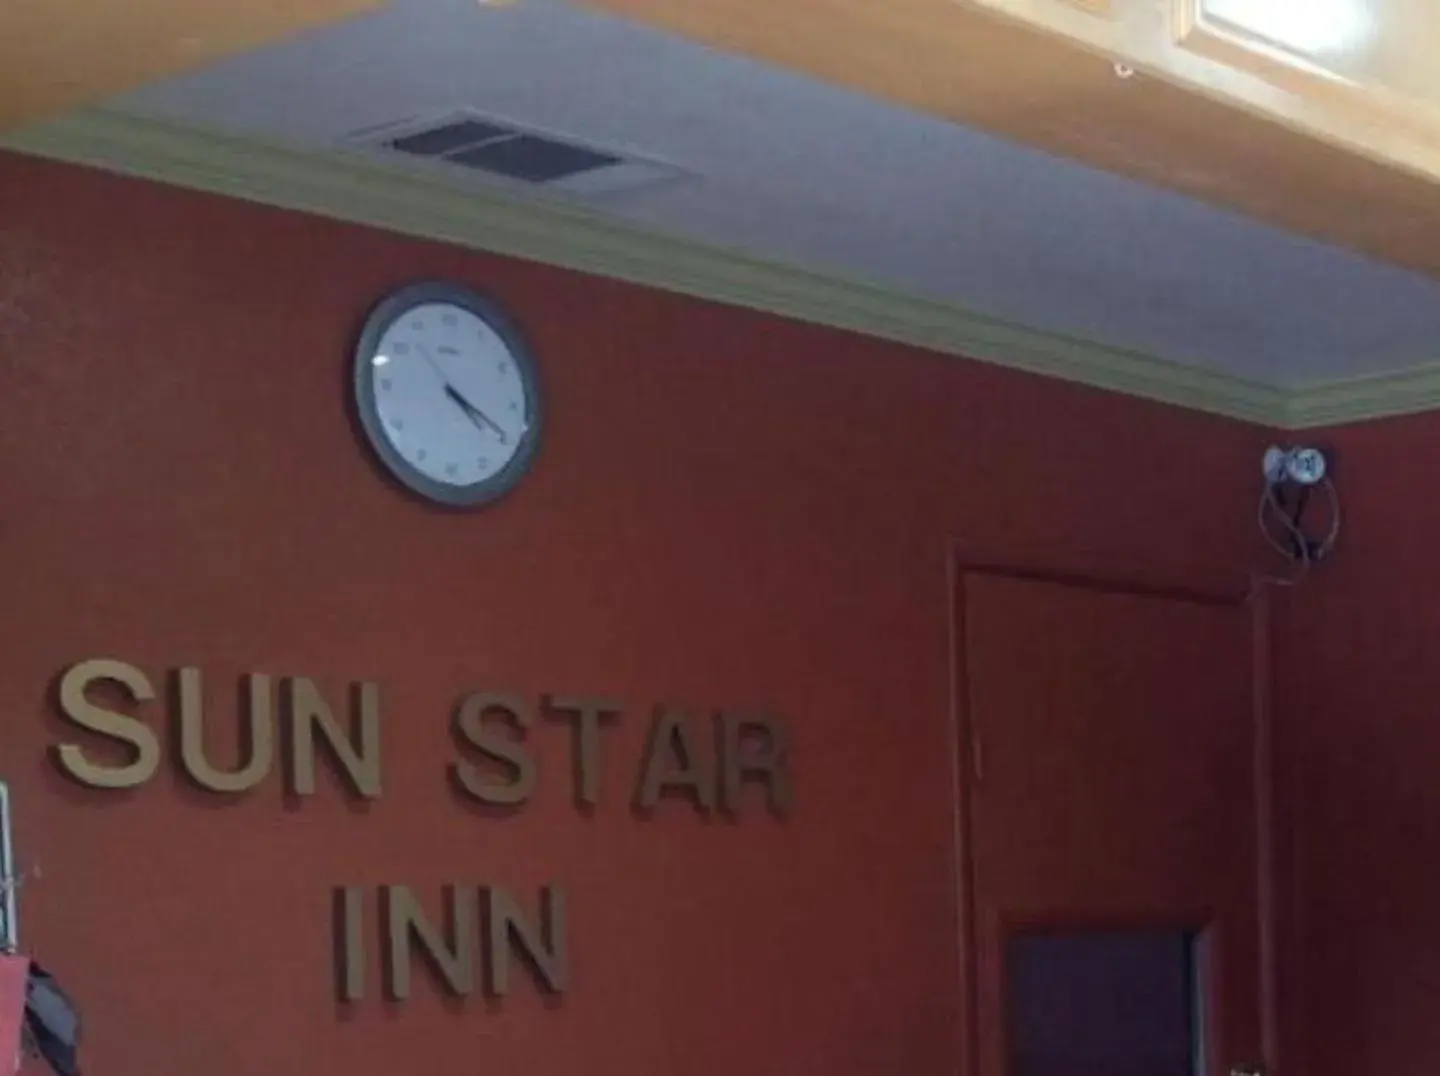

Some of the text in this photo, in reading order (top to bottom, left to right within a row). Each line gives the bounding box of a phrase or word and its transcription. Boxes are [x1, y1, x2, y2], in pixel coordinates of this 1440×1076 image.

[53, 658, 792, 815] SUN STAR
[336, 884, 568, 1003] INN
